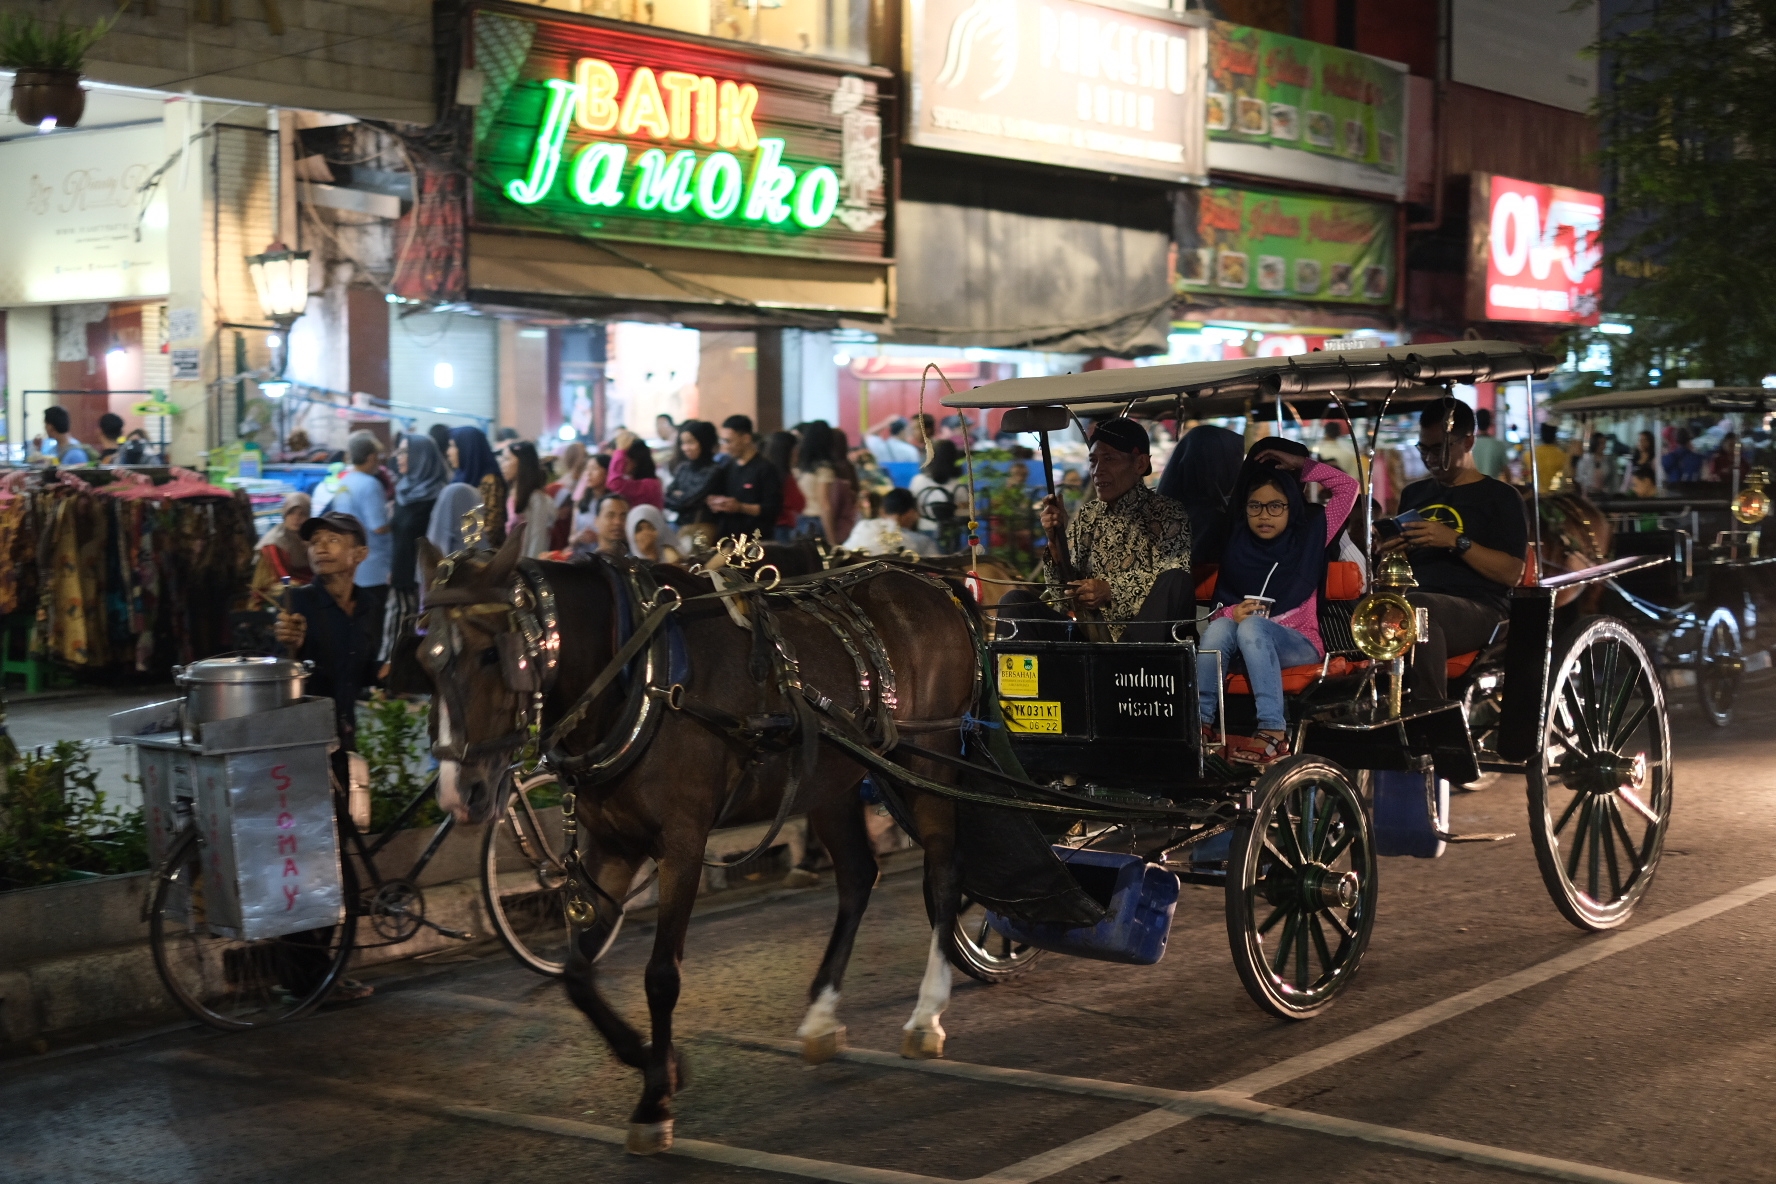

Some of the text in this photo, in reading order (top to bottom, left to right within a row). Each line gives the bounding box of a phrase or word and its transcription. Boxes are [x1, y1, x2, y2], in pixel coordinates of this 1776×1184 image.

[574, 57, 759, 151] BATIK
[1001, 670, 1037, 679] BERSAHAJA
[1114, 667, 1175, 696] andong
[1118, 697, 1174, 717] wisata
